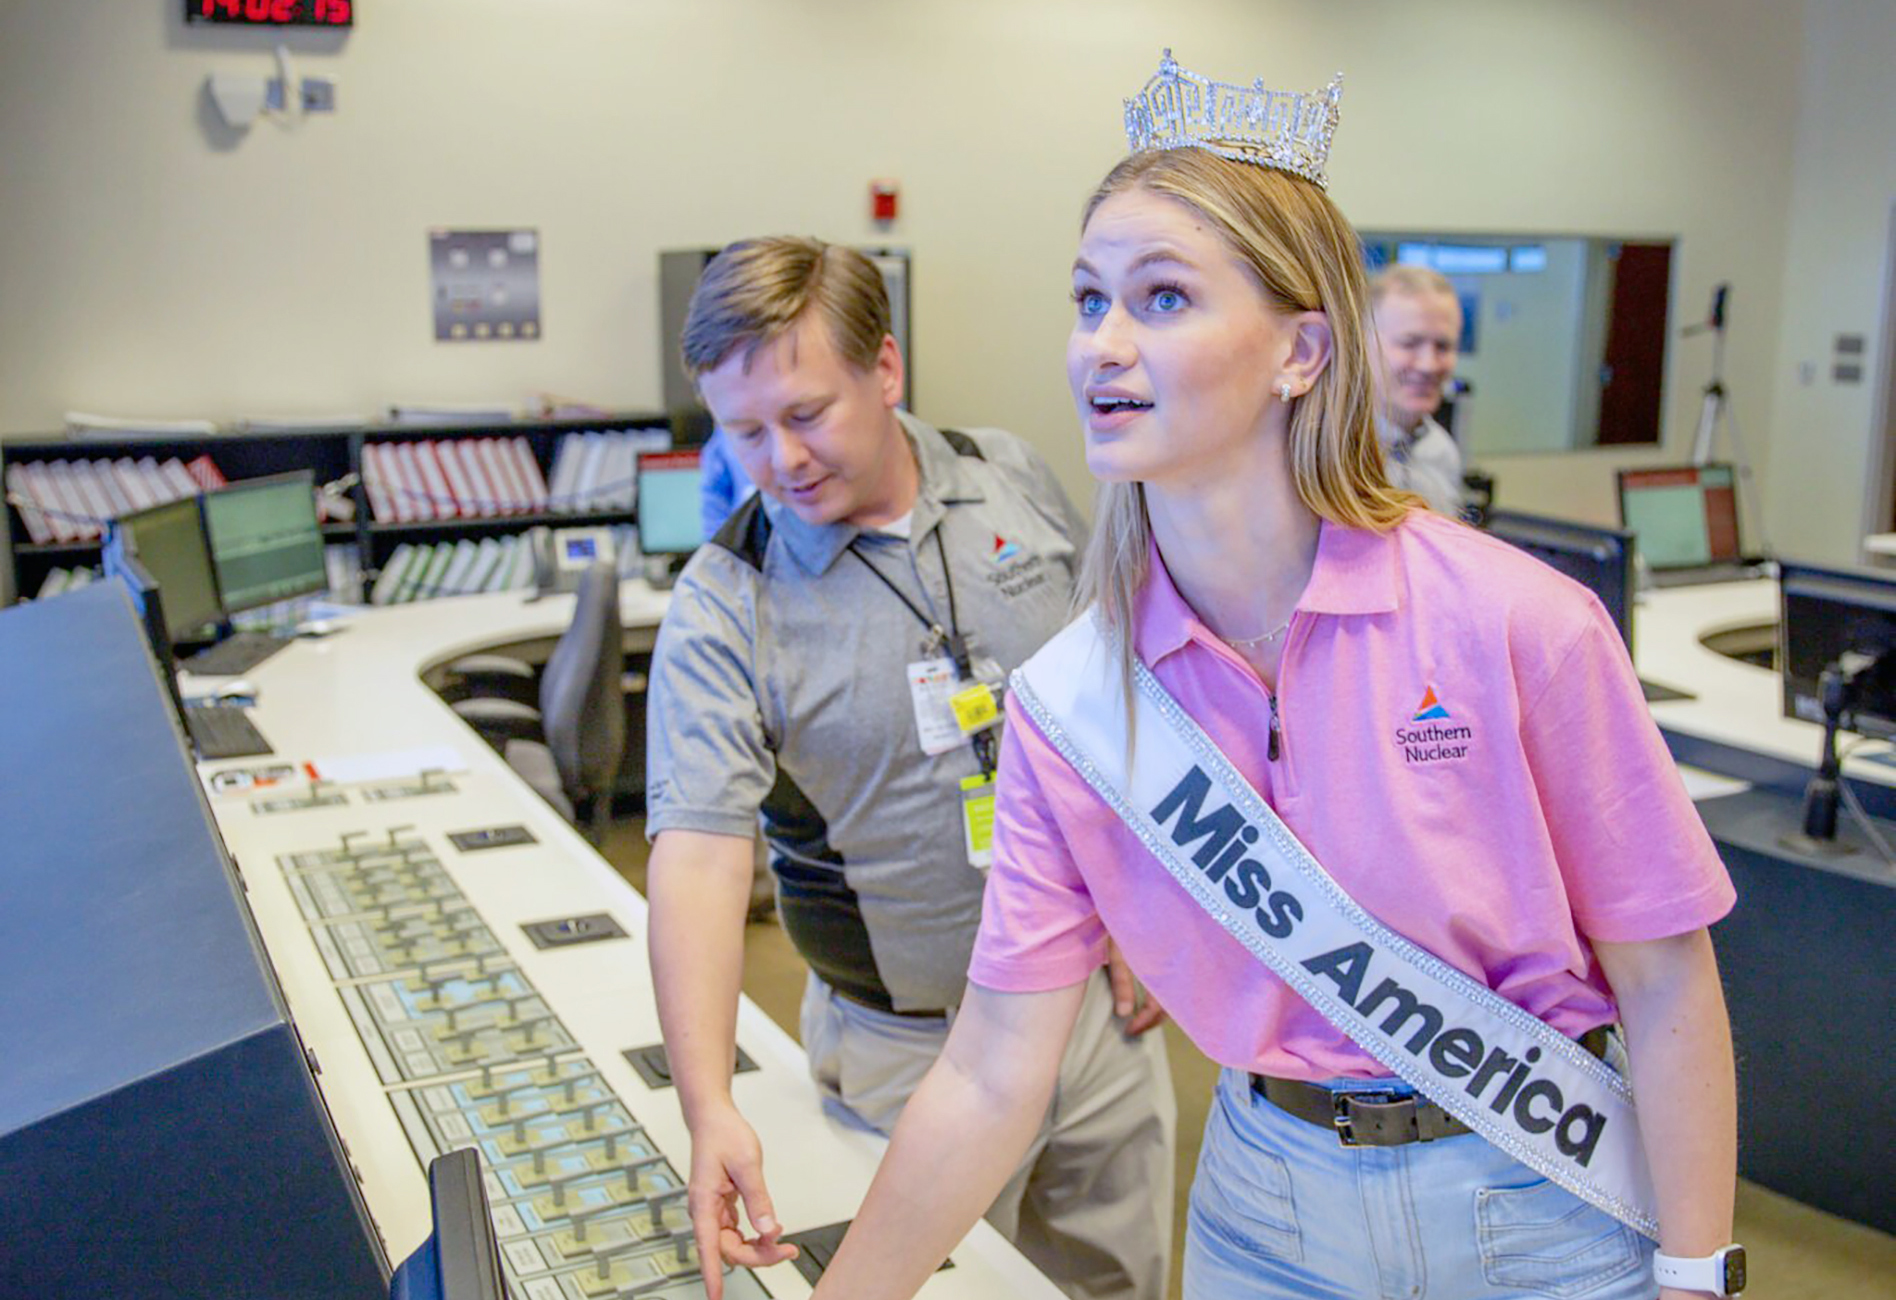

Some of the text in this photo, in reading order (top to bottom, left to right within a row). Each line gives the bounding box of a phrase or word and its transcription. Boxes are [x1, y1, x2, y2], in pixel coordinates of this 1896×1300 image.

[1396, 725, 1471, 745] Southern
[1405, 744, 1468, 763] Nuclear
[1149, 764, 1608, 1168] Miss America
